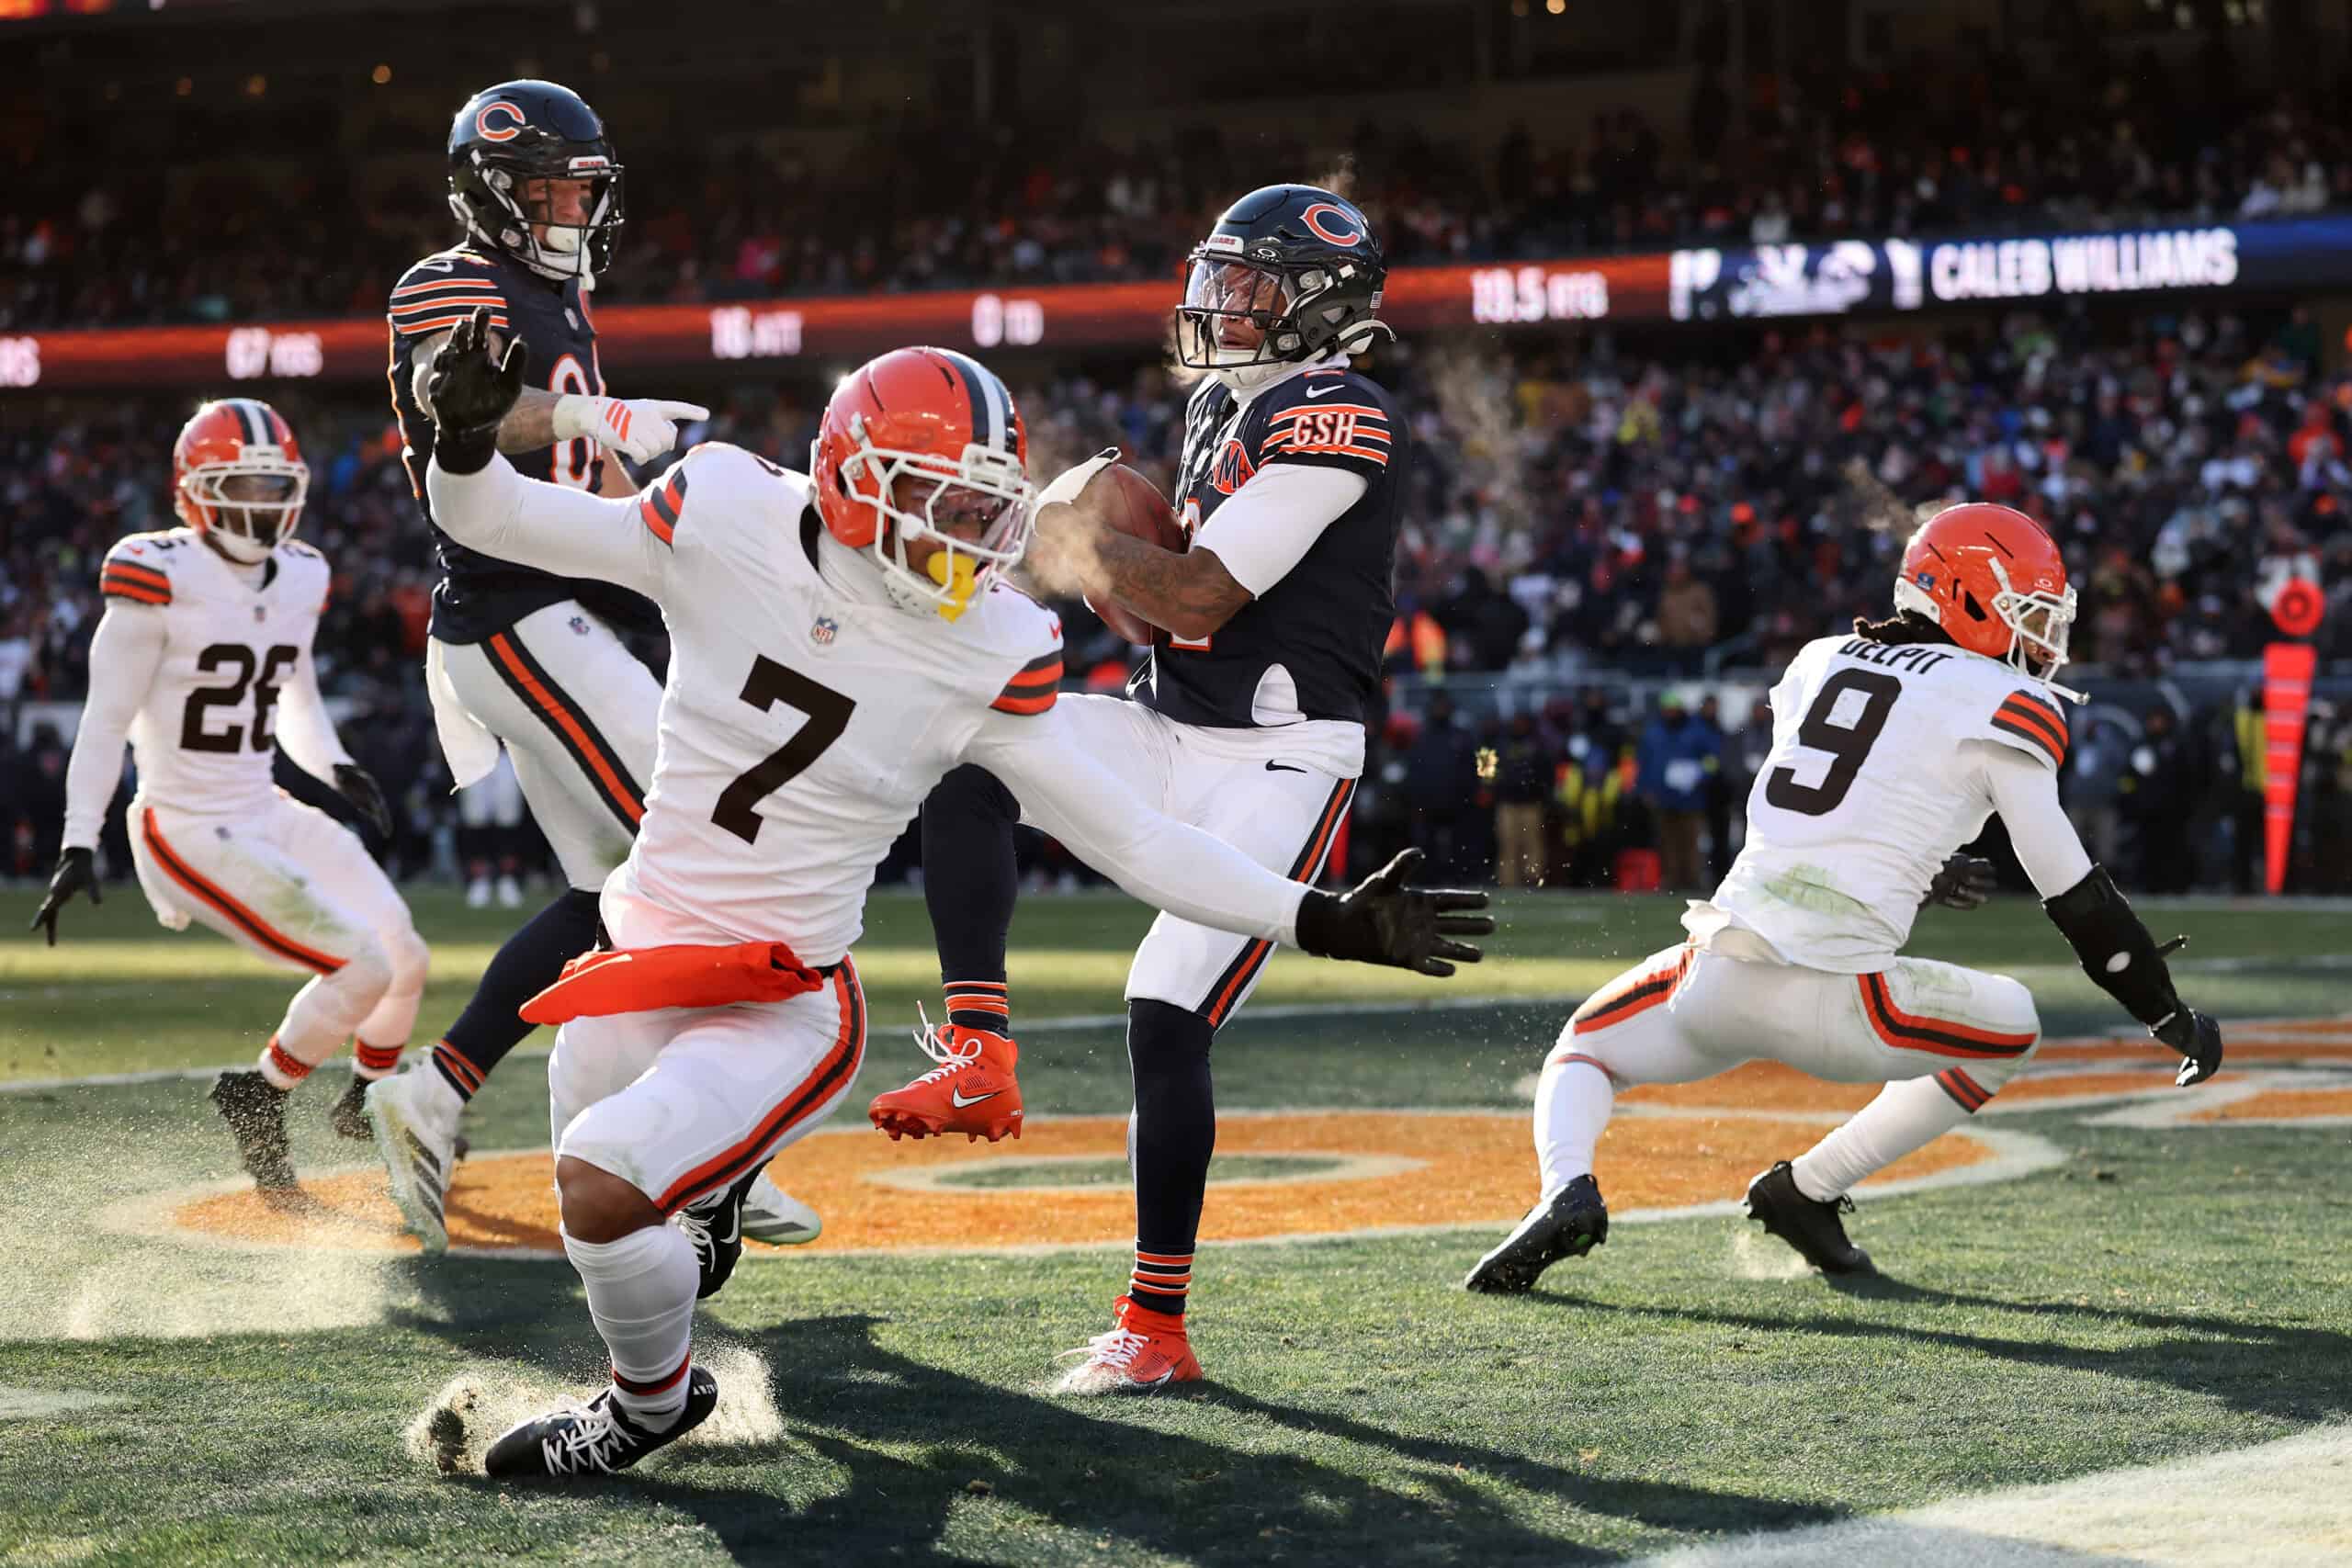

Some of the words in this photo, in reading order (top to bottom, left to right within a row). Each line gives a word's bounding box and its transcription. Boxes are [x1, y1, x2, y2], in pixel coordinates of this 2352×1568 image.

[476, 102, 526, 141] C
[1299, 203, 1361, 247] C
[1931, 239, 2051, 300] CALEB
[2052, 227, 2238, 292] WILLIAMS
[1292, 412, 1357, 447] GSH
[710, 653, 857, 845] 7
[1765, 668, 1903, 816] 9
